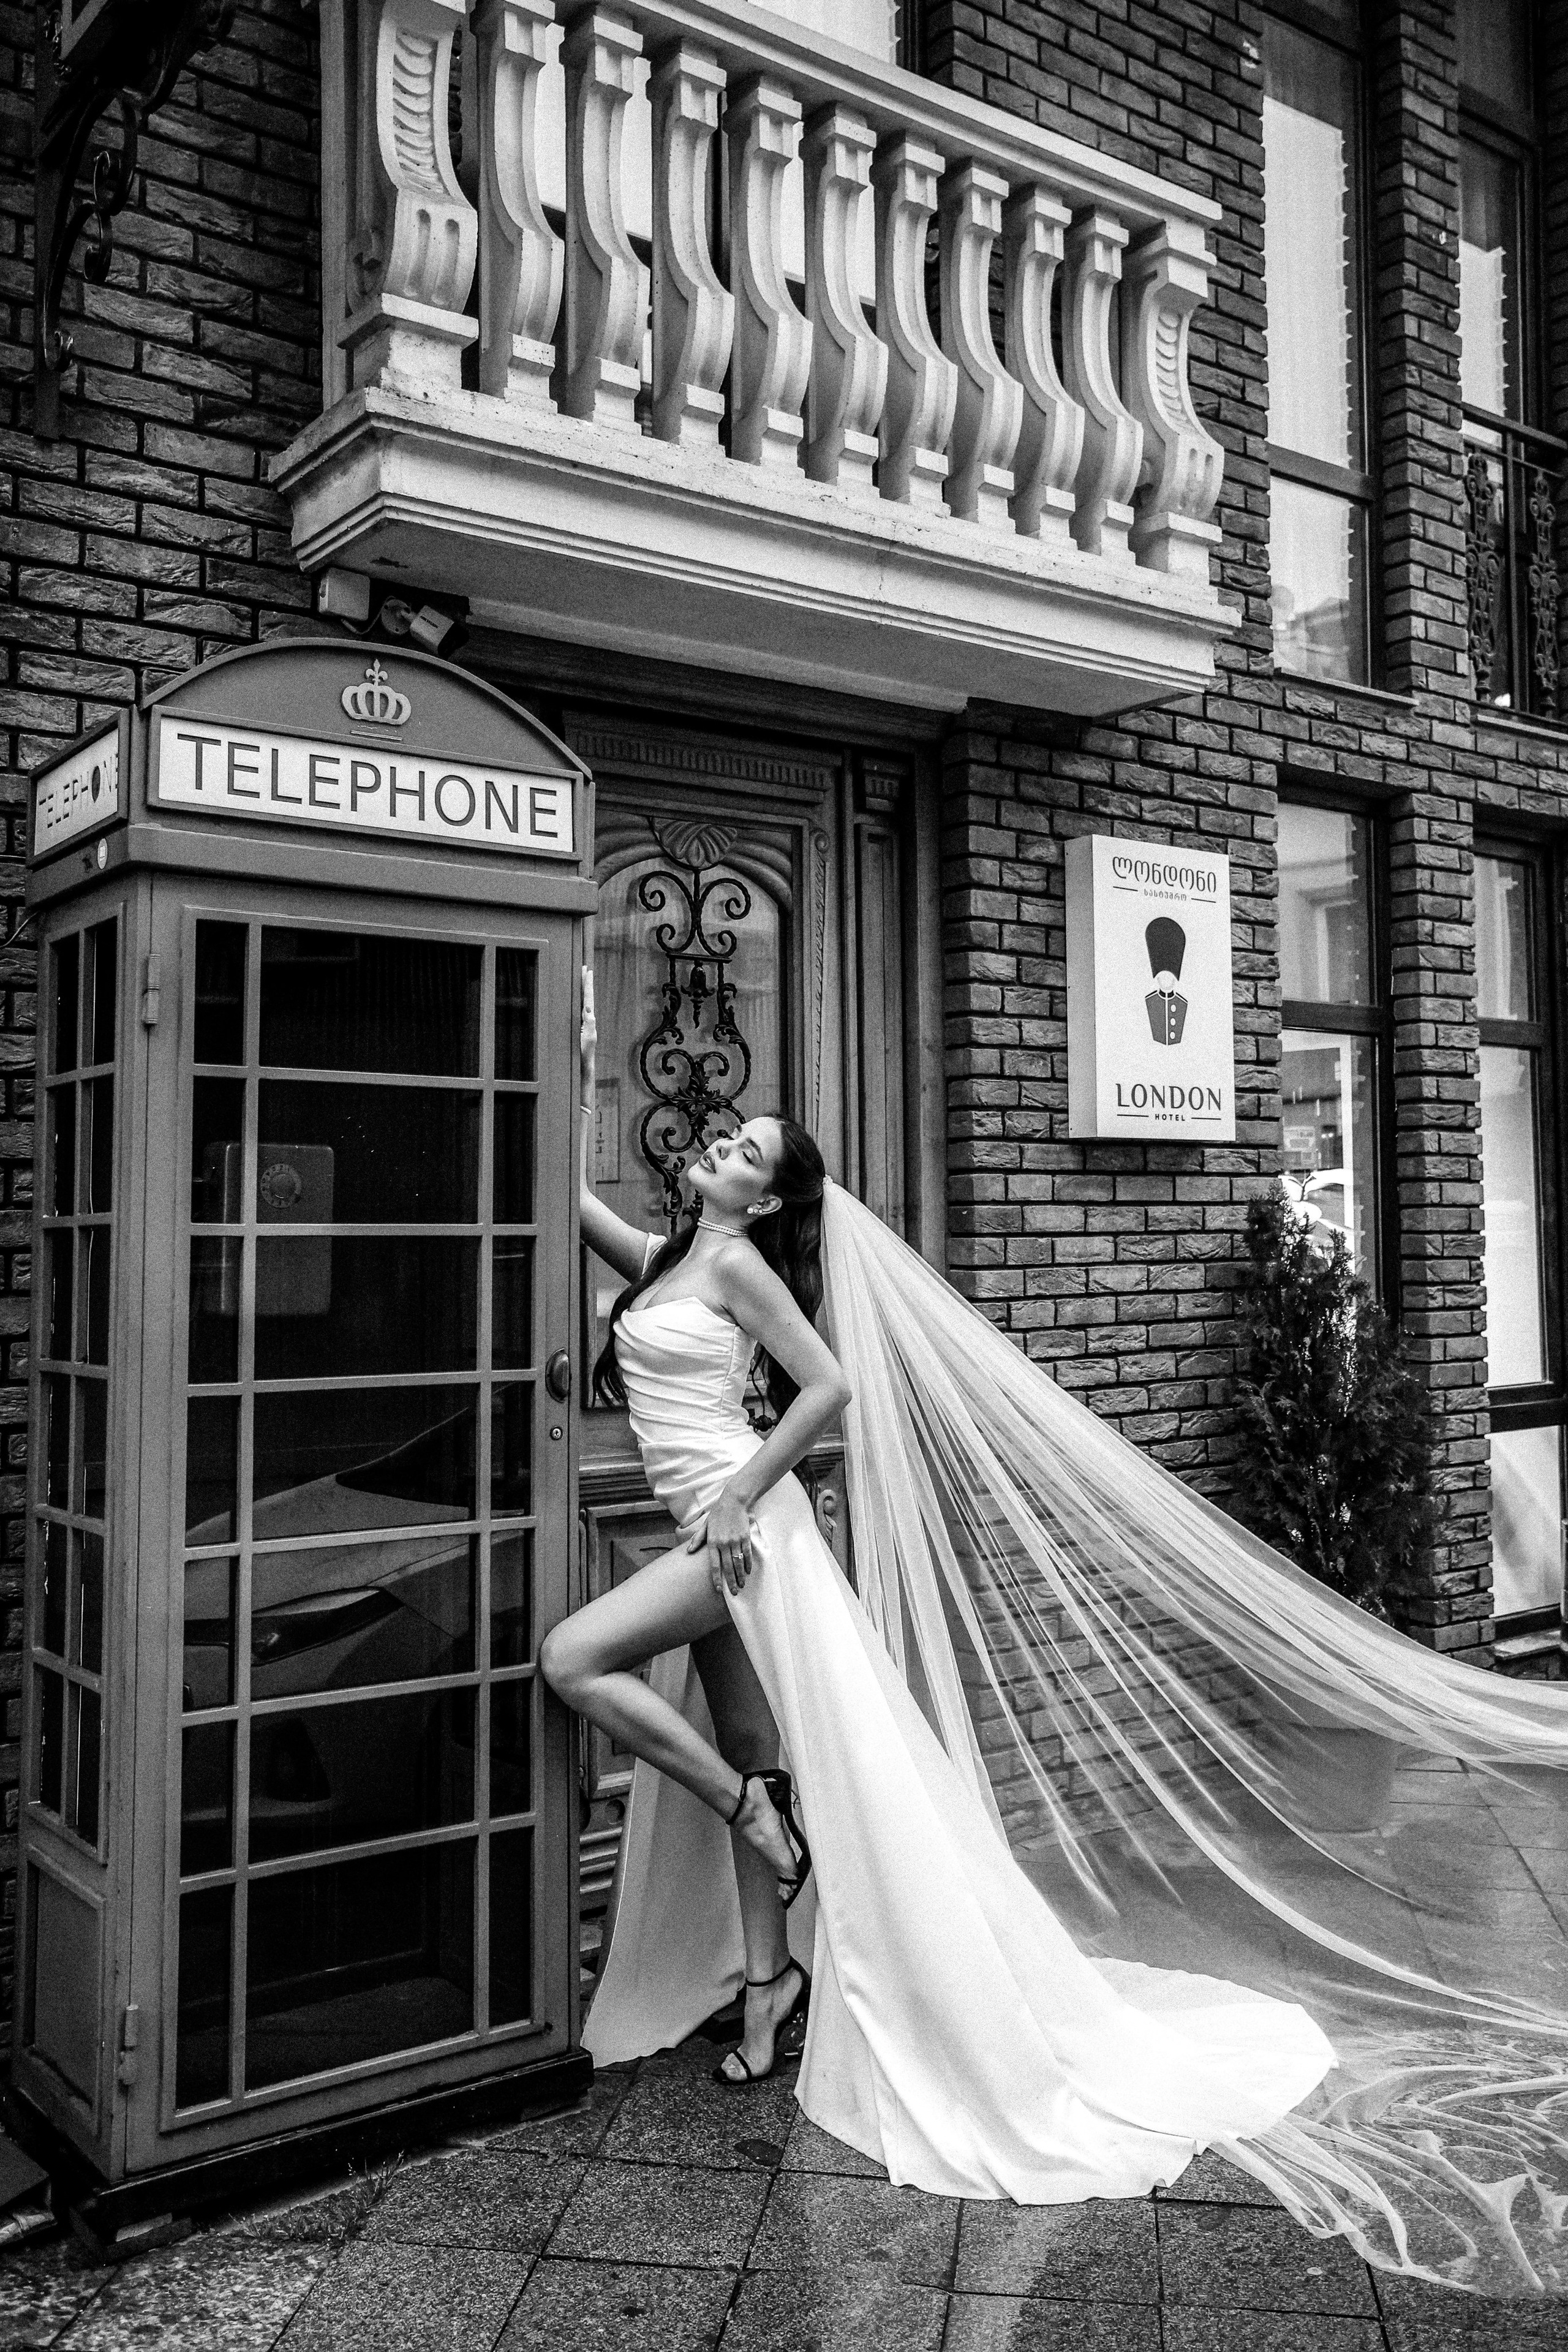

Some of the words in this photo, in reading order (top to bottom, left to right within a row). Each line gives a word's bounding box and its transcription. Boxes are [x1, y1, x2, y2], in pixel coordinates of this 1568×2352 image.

[177, 733, 559, 838] TELEPHONE
[1112, 856, 1216, 892] ლონდონი
[1144, 889, 1187, 901] სასტუმრო
[1115, 1084, 1221, 1110] LONDON
